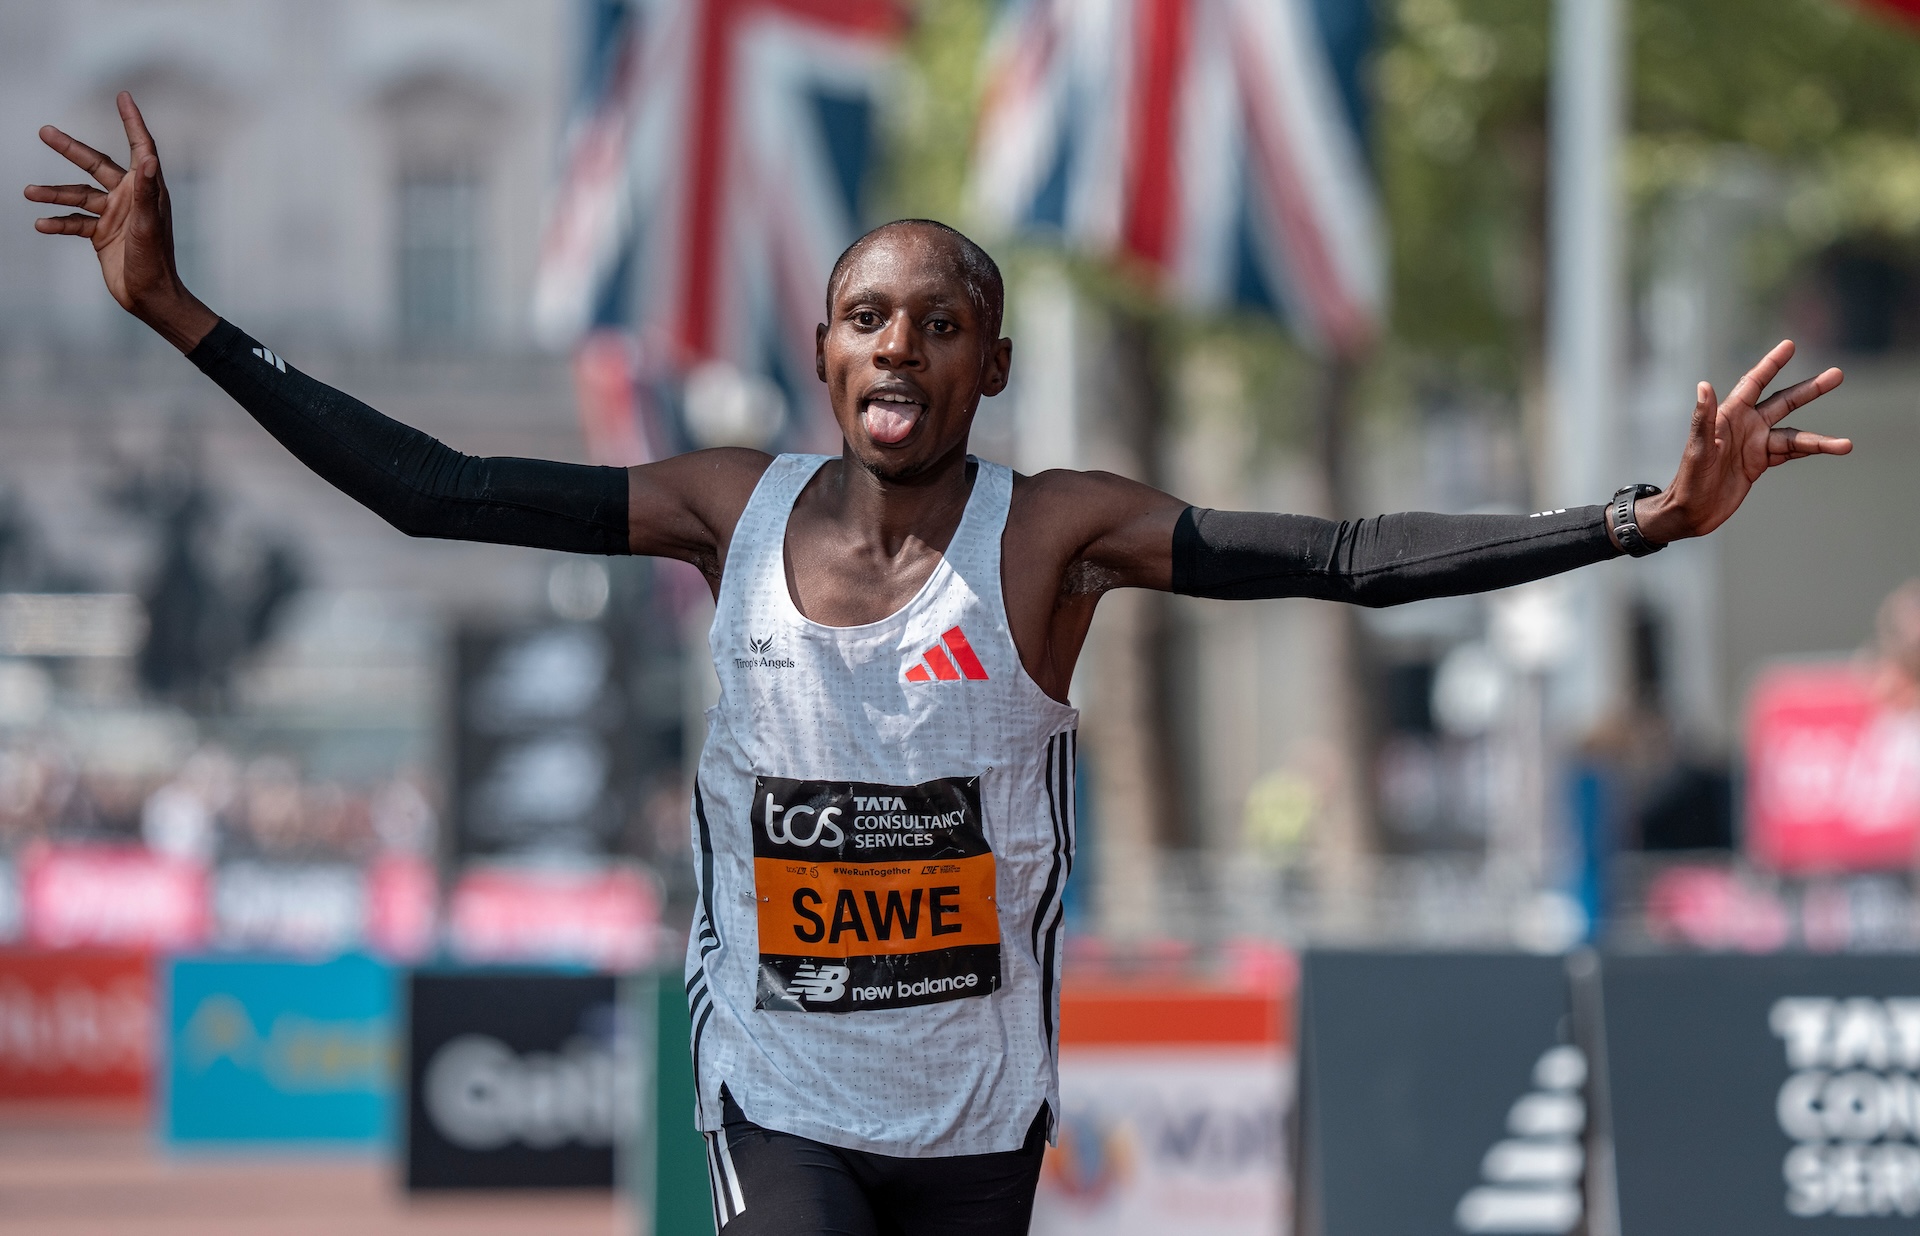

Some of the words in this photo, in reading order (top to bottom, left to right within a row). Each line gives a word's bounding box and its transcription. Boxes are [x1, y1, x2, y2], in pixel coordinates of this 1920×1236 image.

[735, 656, 758, 670] Tirop's
[760, 656, 795, 670] Angels
[853, 796, 907, 811] TATA
[765, 792, 845, 848] tcs
[853, 809, 966, 831] CONSULTANCY
[854, 833, 934, 849] SERVICES
[833, 867, 911, 878] #WeRunTogether
[792, 885, 963, 944] SAWE
[852, 984, 893, 1001] new
[897, 973, 978, 998] balance
